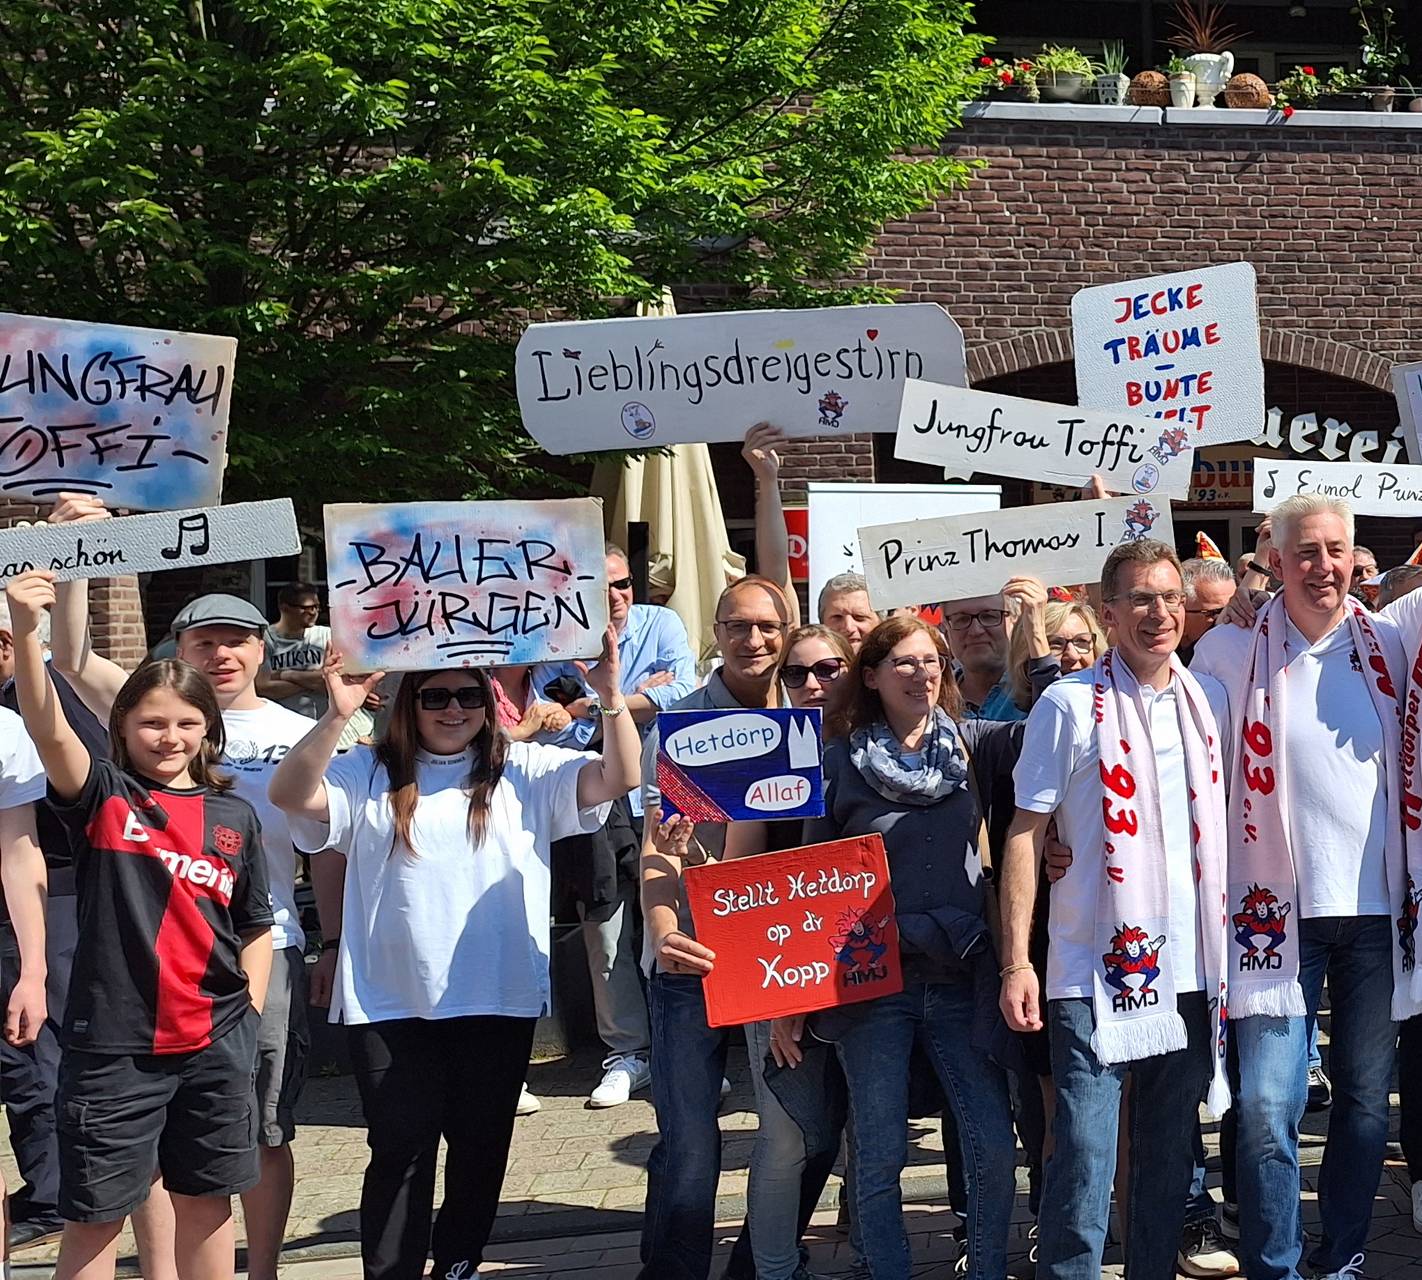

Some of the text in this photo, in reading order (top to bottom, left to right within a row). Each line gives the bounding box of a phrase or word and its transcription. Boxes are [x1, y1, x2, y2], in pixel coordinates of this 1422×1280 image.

[1114, 283, 1204, 324] JECKE
[1103, 323, 1222, 365] TRÄUME
[532, 334, 925, 405] Lieblingsdreigestirn
[1126, 370, 1213, 406] BUNTE
[913, 399, 1147, 471] Jungfrau Toffi
[49, 537, 128, 571] schön
[879, 539, 961, 581] Prinz
[964, 527, 1081, 565] Thomas
[361, 589, 592, 640] JÜRGEN
[672, 724, 775, 760] Hetdörp
[749, 779, 806, 805] Allaf
[712, 864, 877, 919] Stellt Hetdörp
[766, 924, 792, 946] op
[756, 955, 830, 989] Kopp
